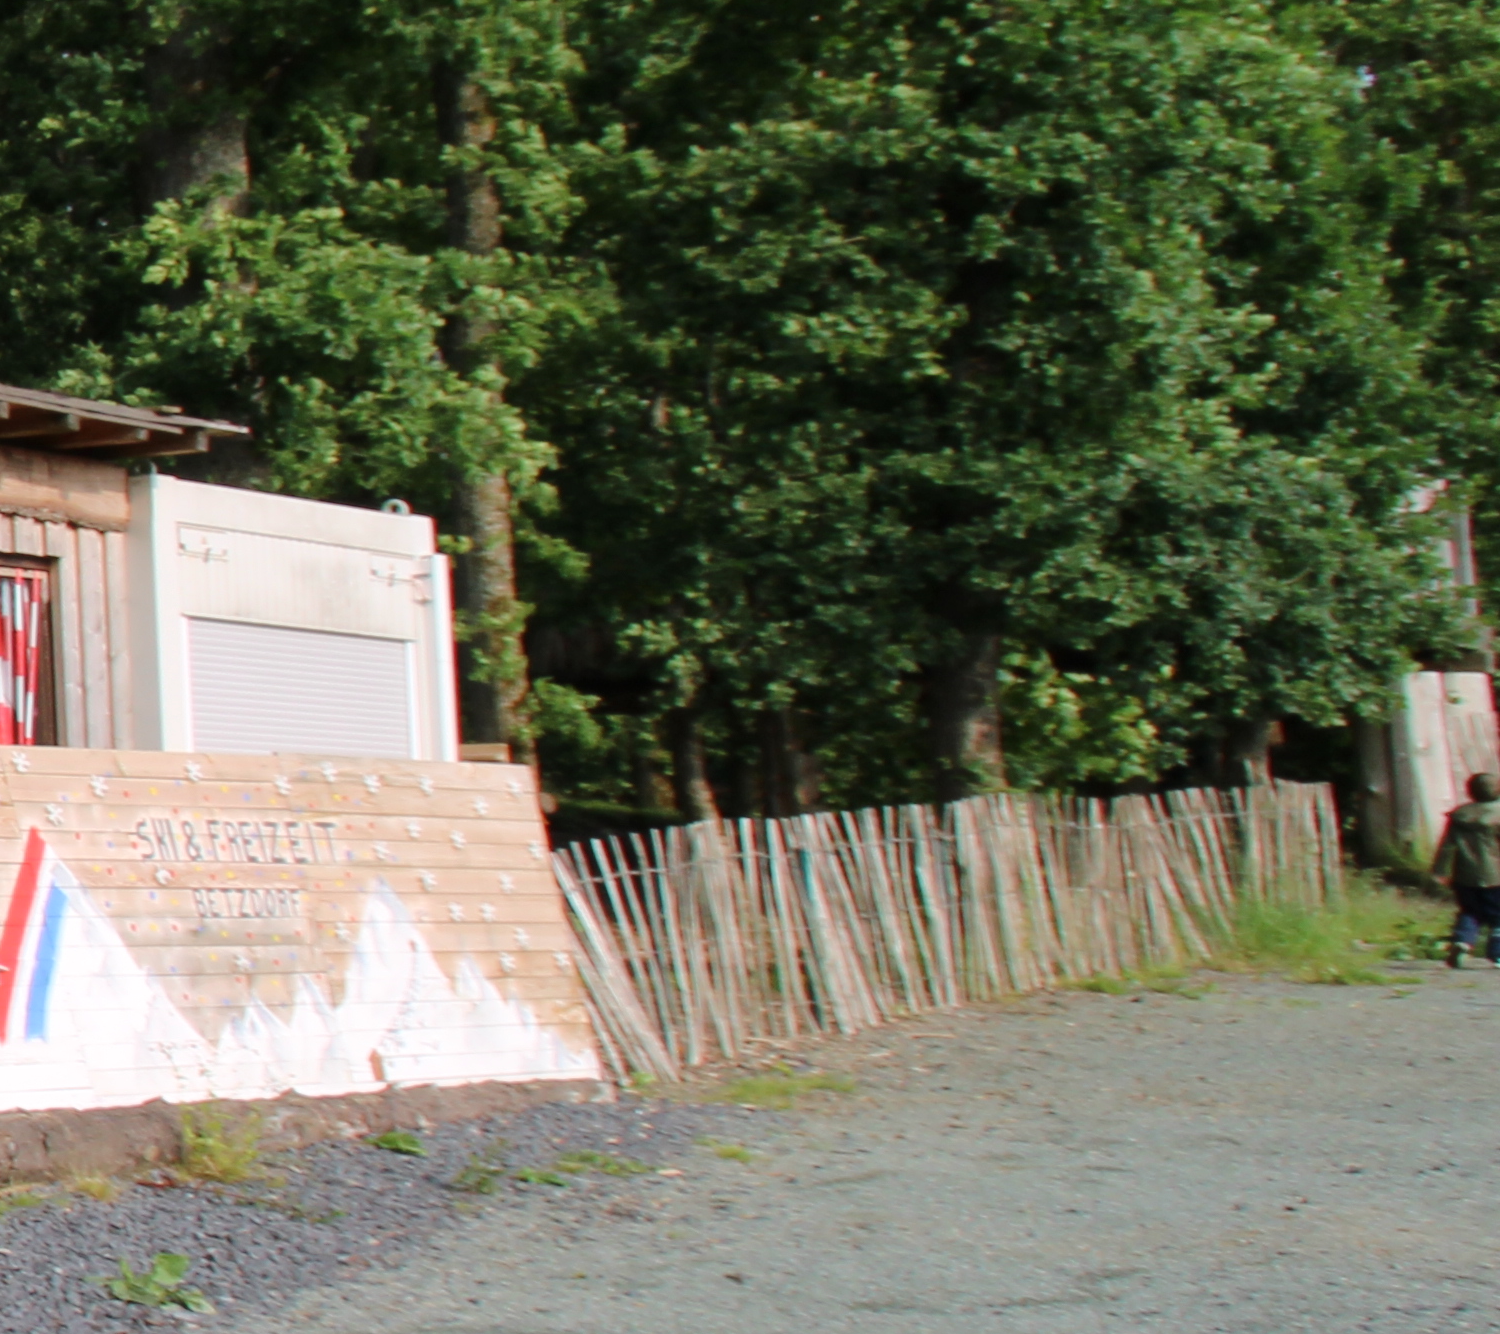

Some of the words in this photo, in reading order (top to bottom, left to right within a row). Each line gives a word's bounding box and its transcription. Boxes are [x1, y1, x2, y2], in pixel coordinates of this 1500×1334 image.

[136, 818, 179, 860] SKI
[182, 820, 203, 862] &
[206, 819, 338, 864] FREIZEIT
[193, 888, 301, 917] BETZDORF
